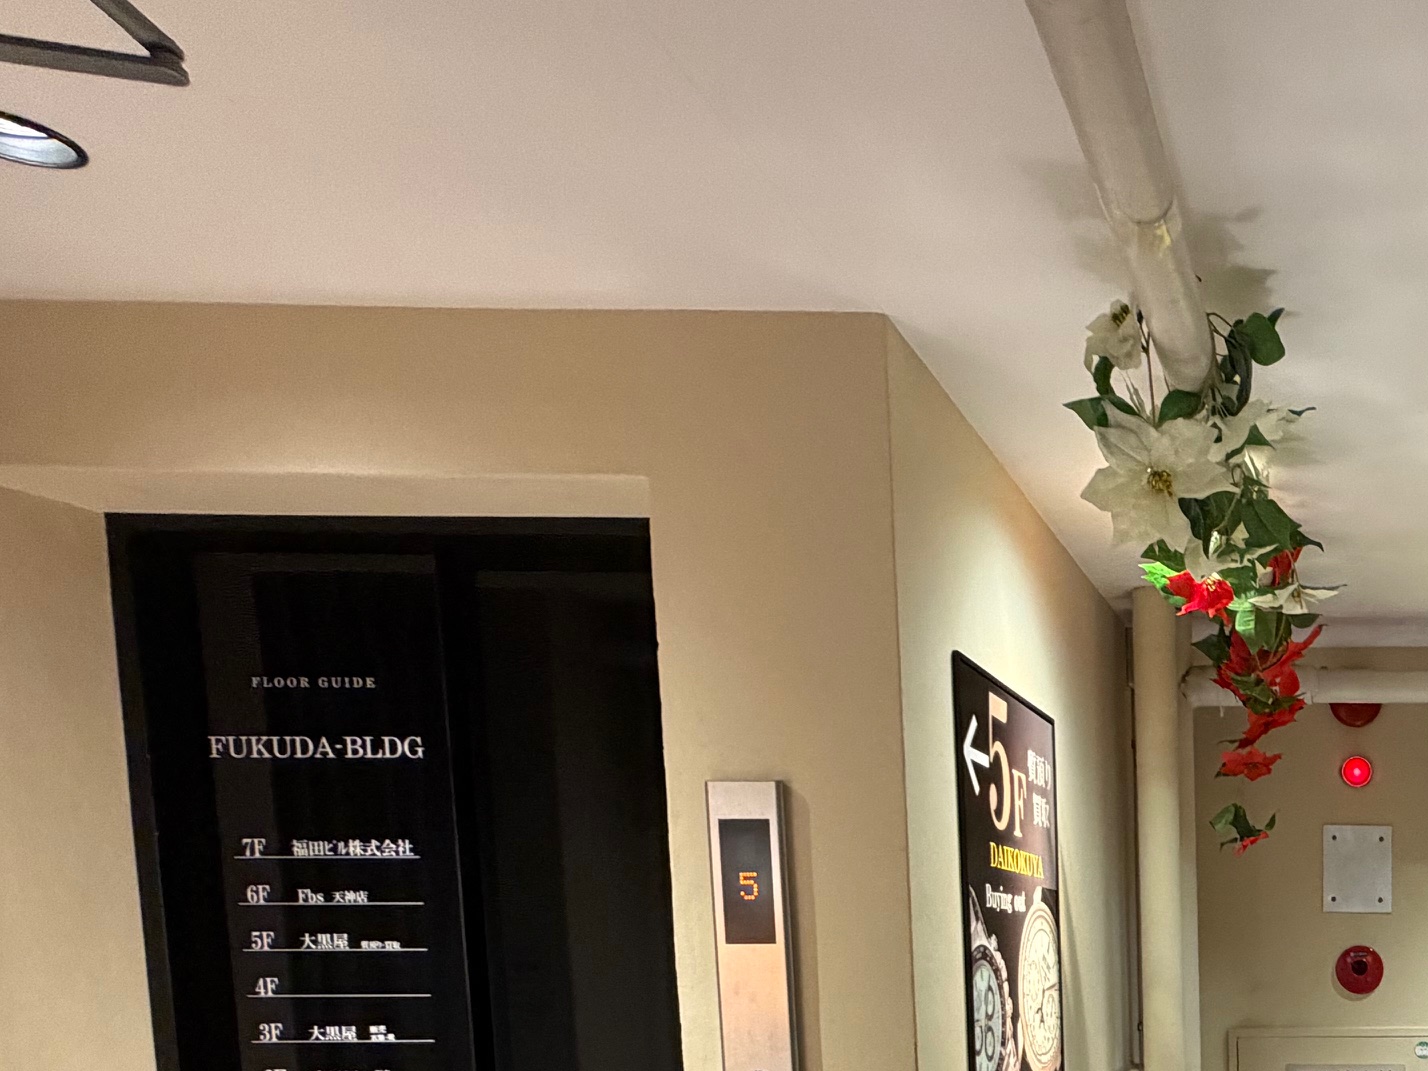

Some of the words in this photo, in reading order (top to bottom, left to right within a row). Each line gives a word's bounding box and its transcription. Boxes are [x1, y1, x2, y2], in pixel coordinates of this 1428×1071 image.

[251, 676, 310, 688] FLOOR
[318, 676, 376, 689] GUIDE
[207, 735, 425, 759] FUKUDA-BLDG
[1033, 792, 1050, 828] 買取
[241, 838, 266, 857] 7F
[291, 839, 415, 857] 福田ビル株式会社
[989, 841, 1044, 879] DAIKOKUYA
[246, 885, 271, 903] 6F
[738, 871, 759, 901] 5
[985, 883, 1013, 914] Buying
[250, 931, 275, 950] 5F
[299, 933, 349, 950] 大黒屋
[254, 977, 279, 996] 4F
[258, 1023, 283, 1041] 3F
[308, 1025, 358, 1041] 大黒屋
